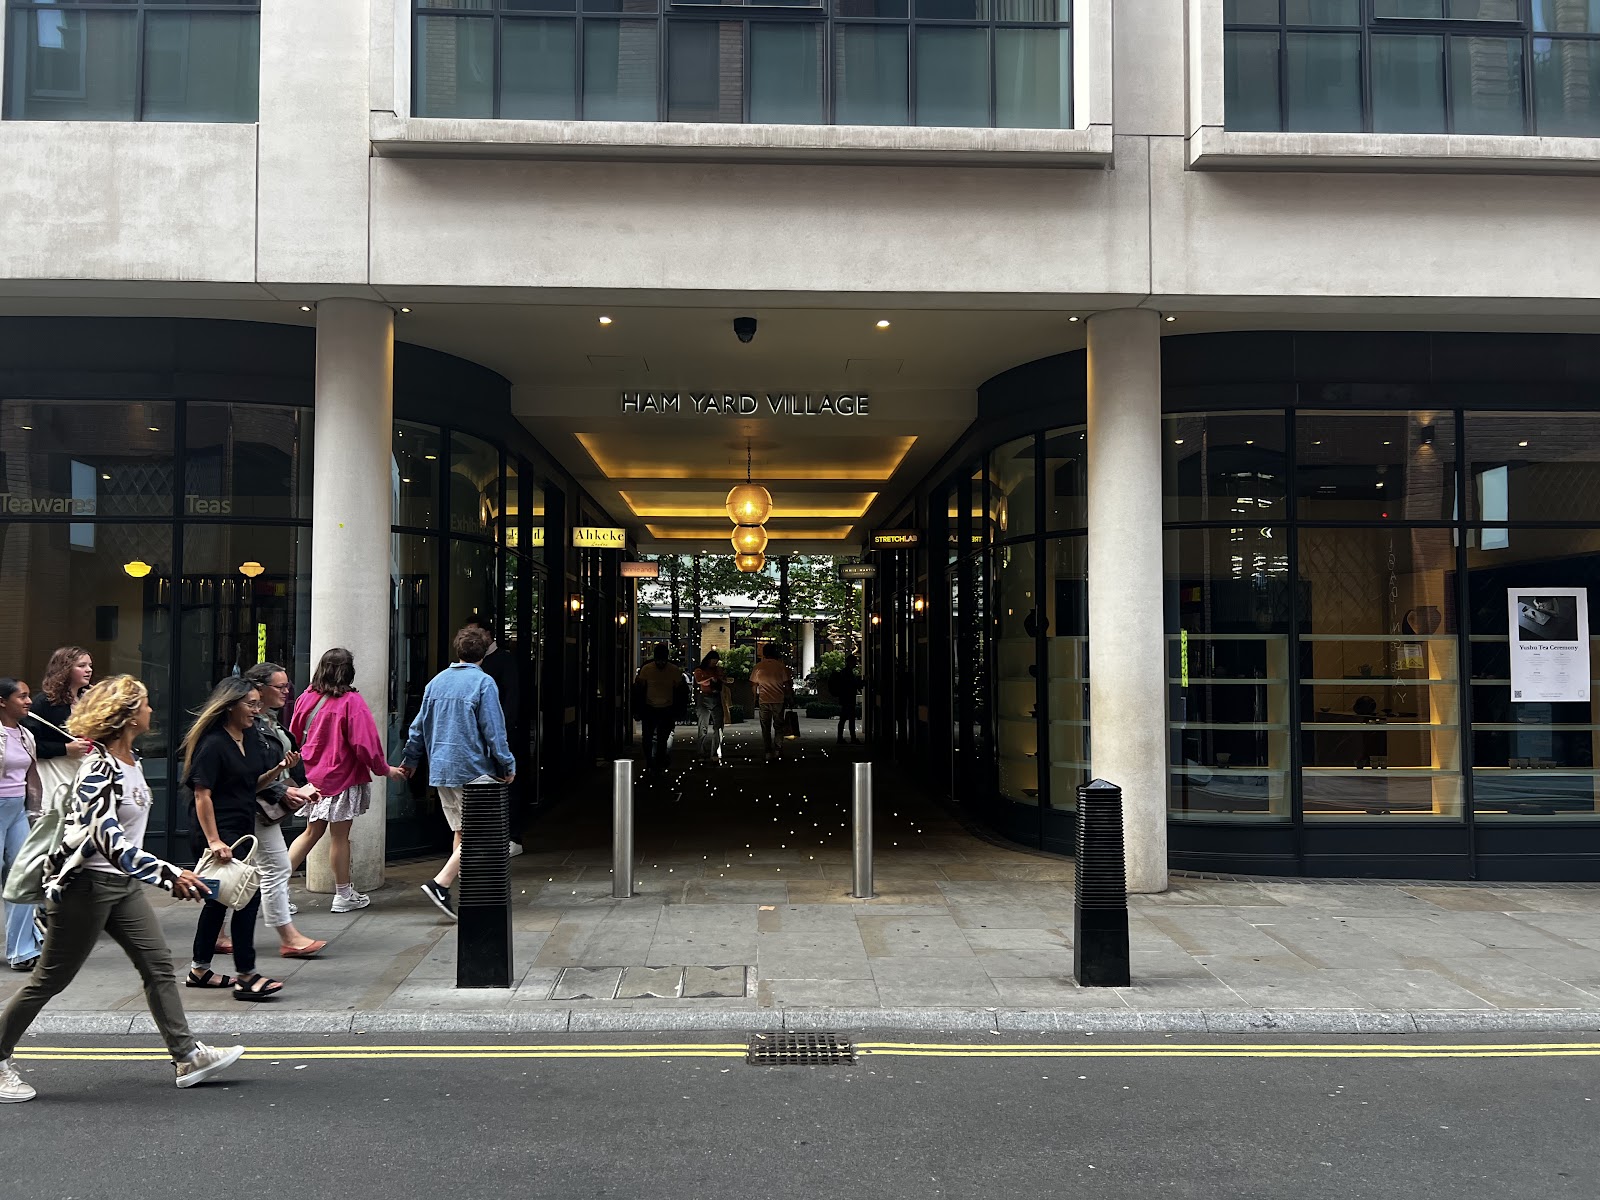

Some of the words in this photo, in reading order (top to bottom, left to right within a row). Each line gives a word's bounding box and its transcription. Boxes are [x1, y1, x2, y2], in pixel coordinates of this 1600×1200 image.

[622, 392, 681, 413] HAM
[689, 393, 758, 415] YARD
[767, 394, 869, 416] VILLAGE
[0, 493, 97, 514] Teawares
[185, 494, 231, 514] Teas
[874, 535, 918, 543] STRETCHLAB
